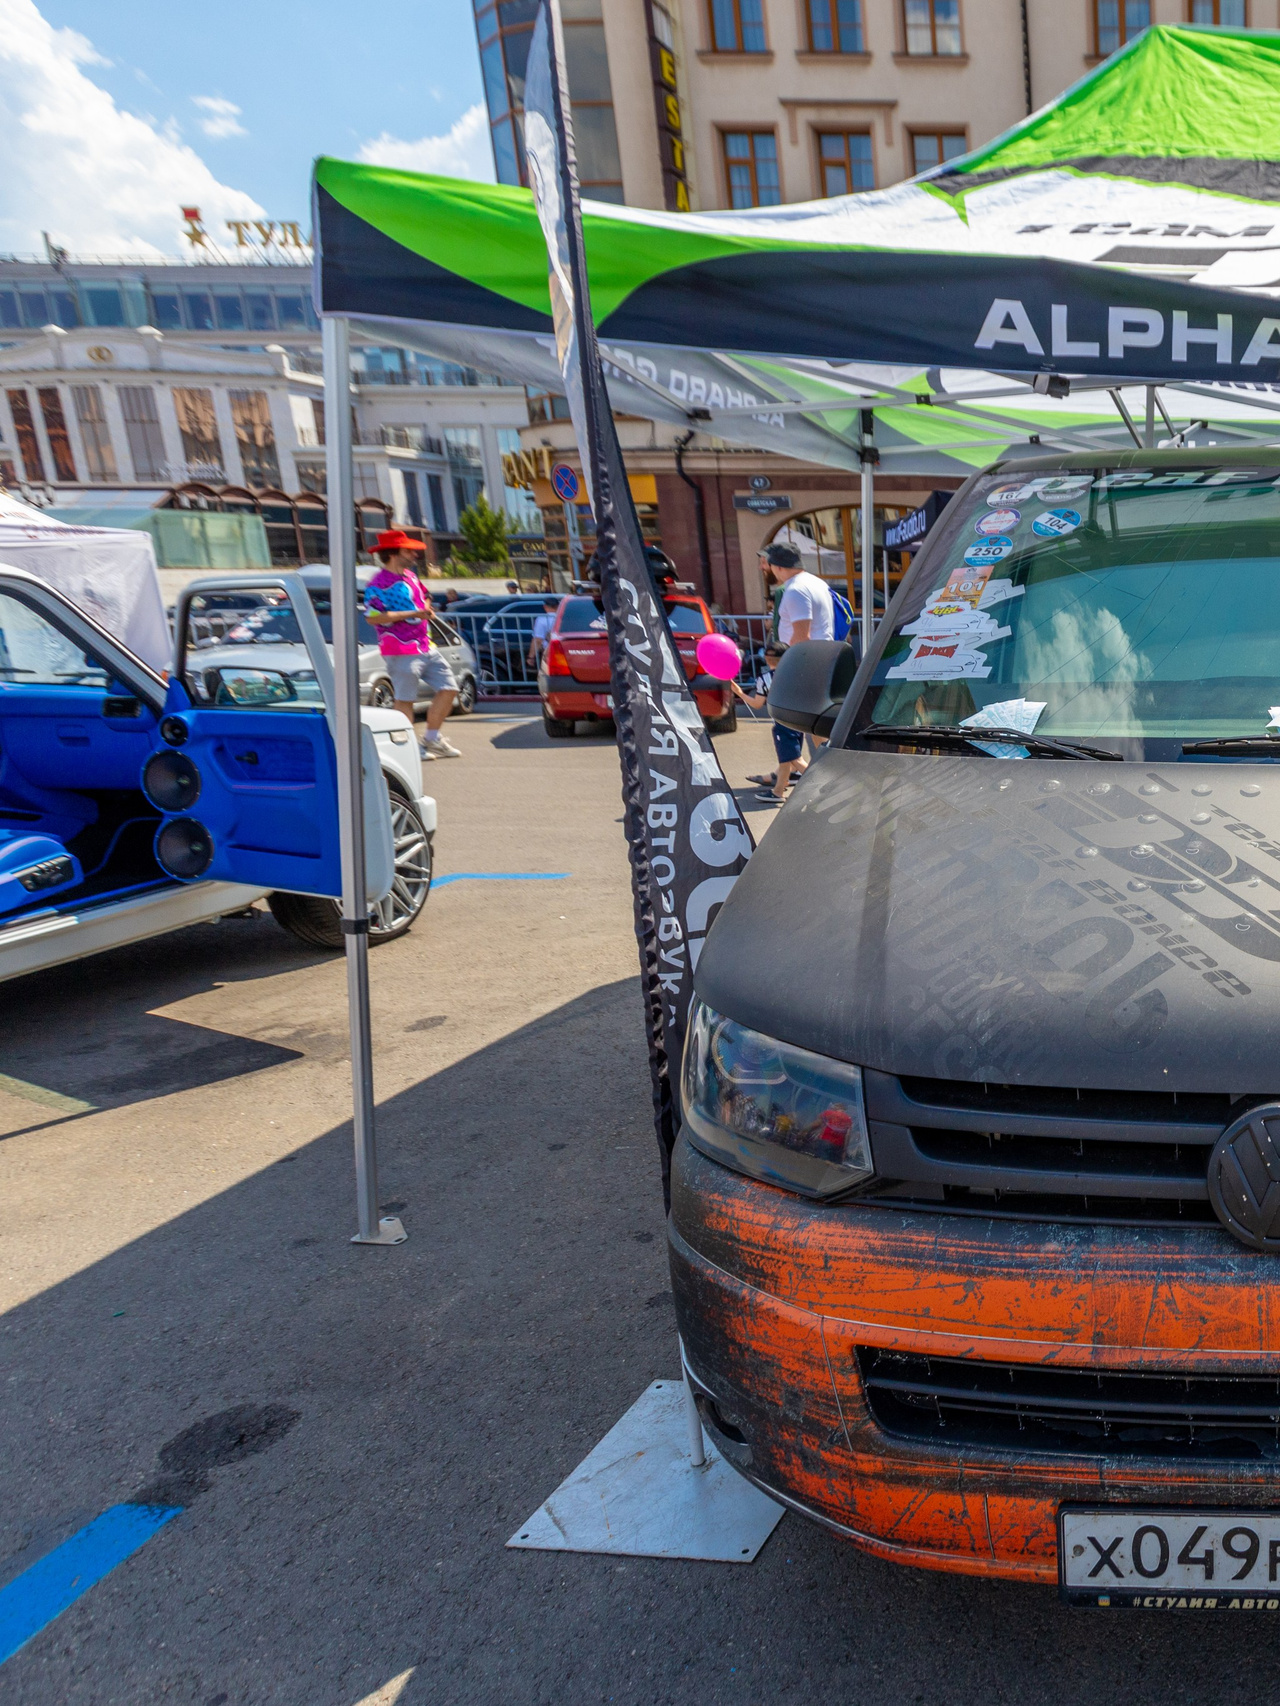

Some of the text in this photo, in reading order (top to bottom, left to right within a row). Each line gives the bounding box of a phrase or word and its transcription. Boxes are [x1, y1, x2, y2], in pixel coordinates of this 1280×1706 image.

[226, 220, 313, 249] ТУЛ
[1044, 517, 1068, 530] 104
[971, 547, 1003, 556] 250
[948, 580, 985, 593] 101
